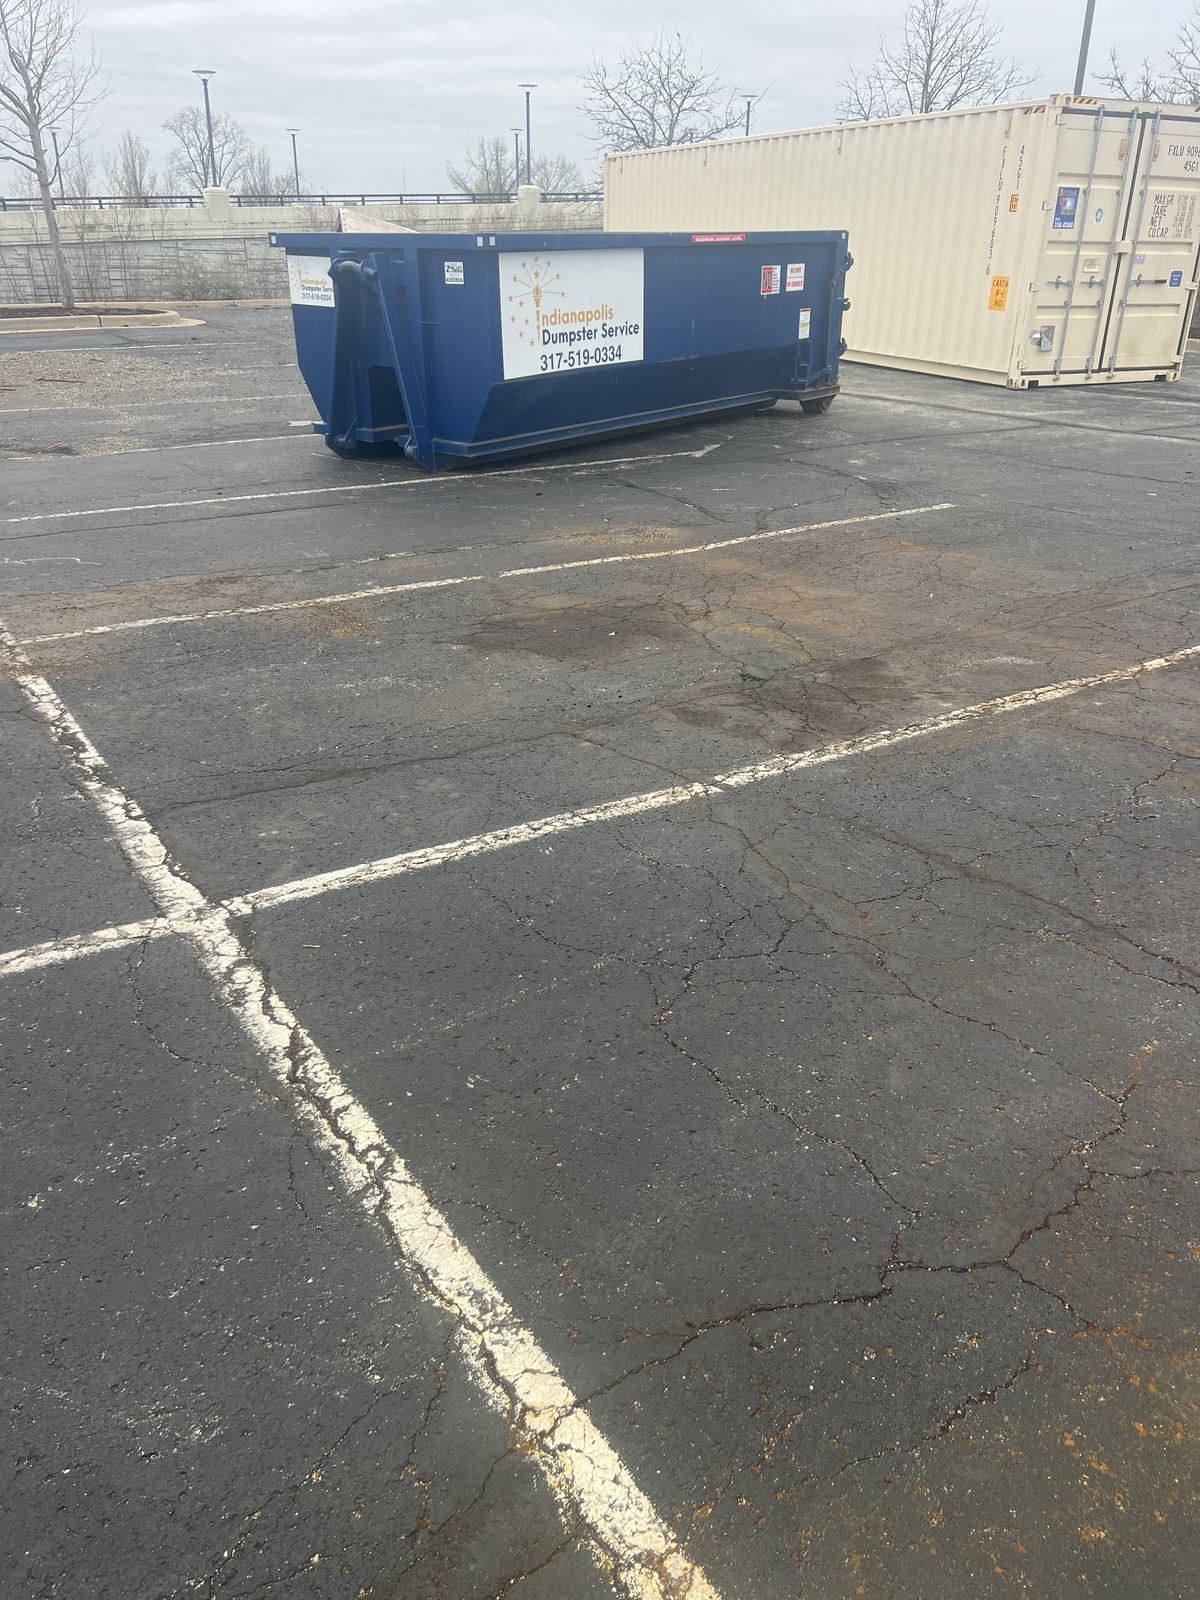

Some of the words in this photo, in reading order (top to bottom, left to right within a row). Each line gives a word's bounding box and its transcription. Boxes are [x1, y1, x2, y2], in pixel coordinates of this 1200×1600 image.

[1167, 145, 1184, 157] FXLU
[1152, 205, 1168, 216] TARE
[1150, 216, 1162, 227] NET
[536, 304, 614, 327] Indianapolis
[542, 326, 598, 346] Dumpster
[601, 321, 640, 338] Service
[540, 344, 622, 371] 317-519-0334
